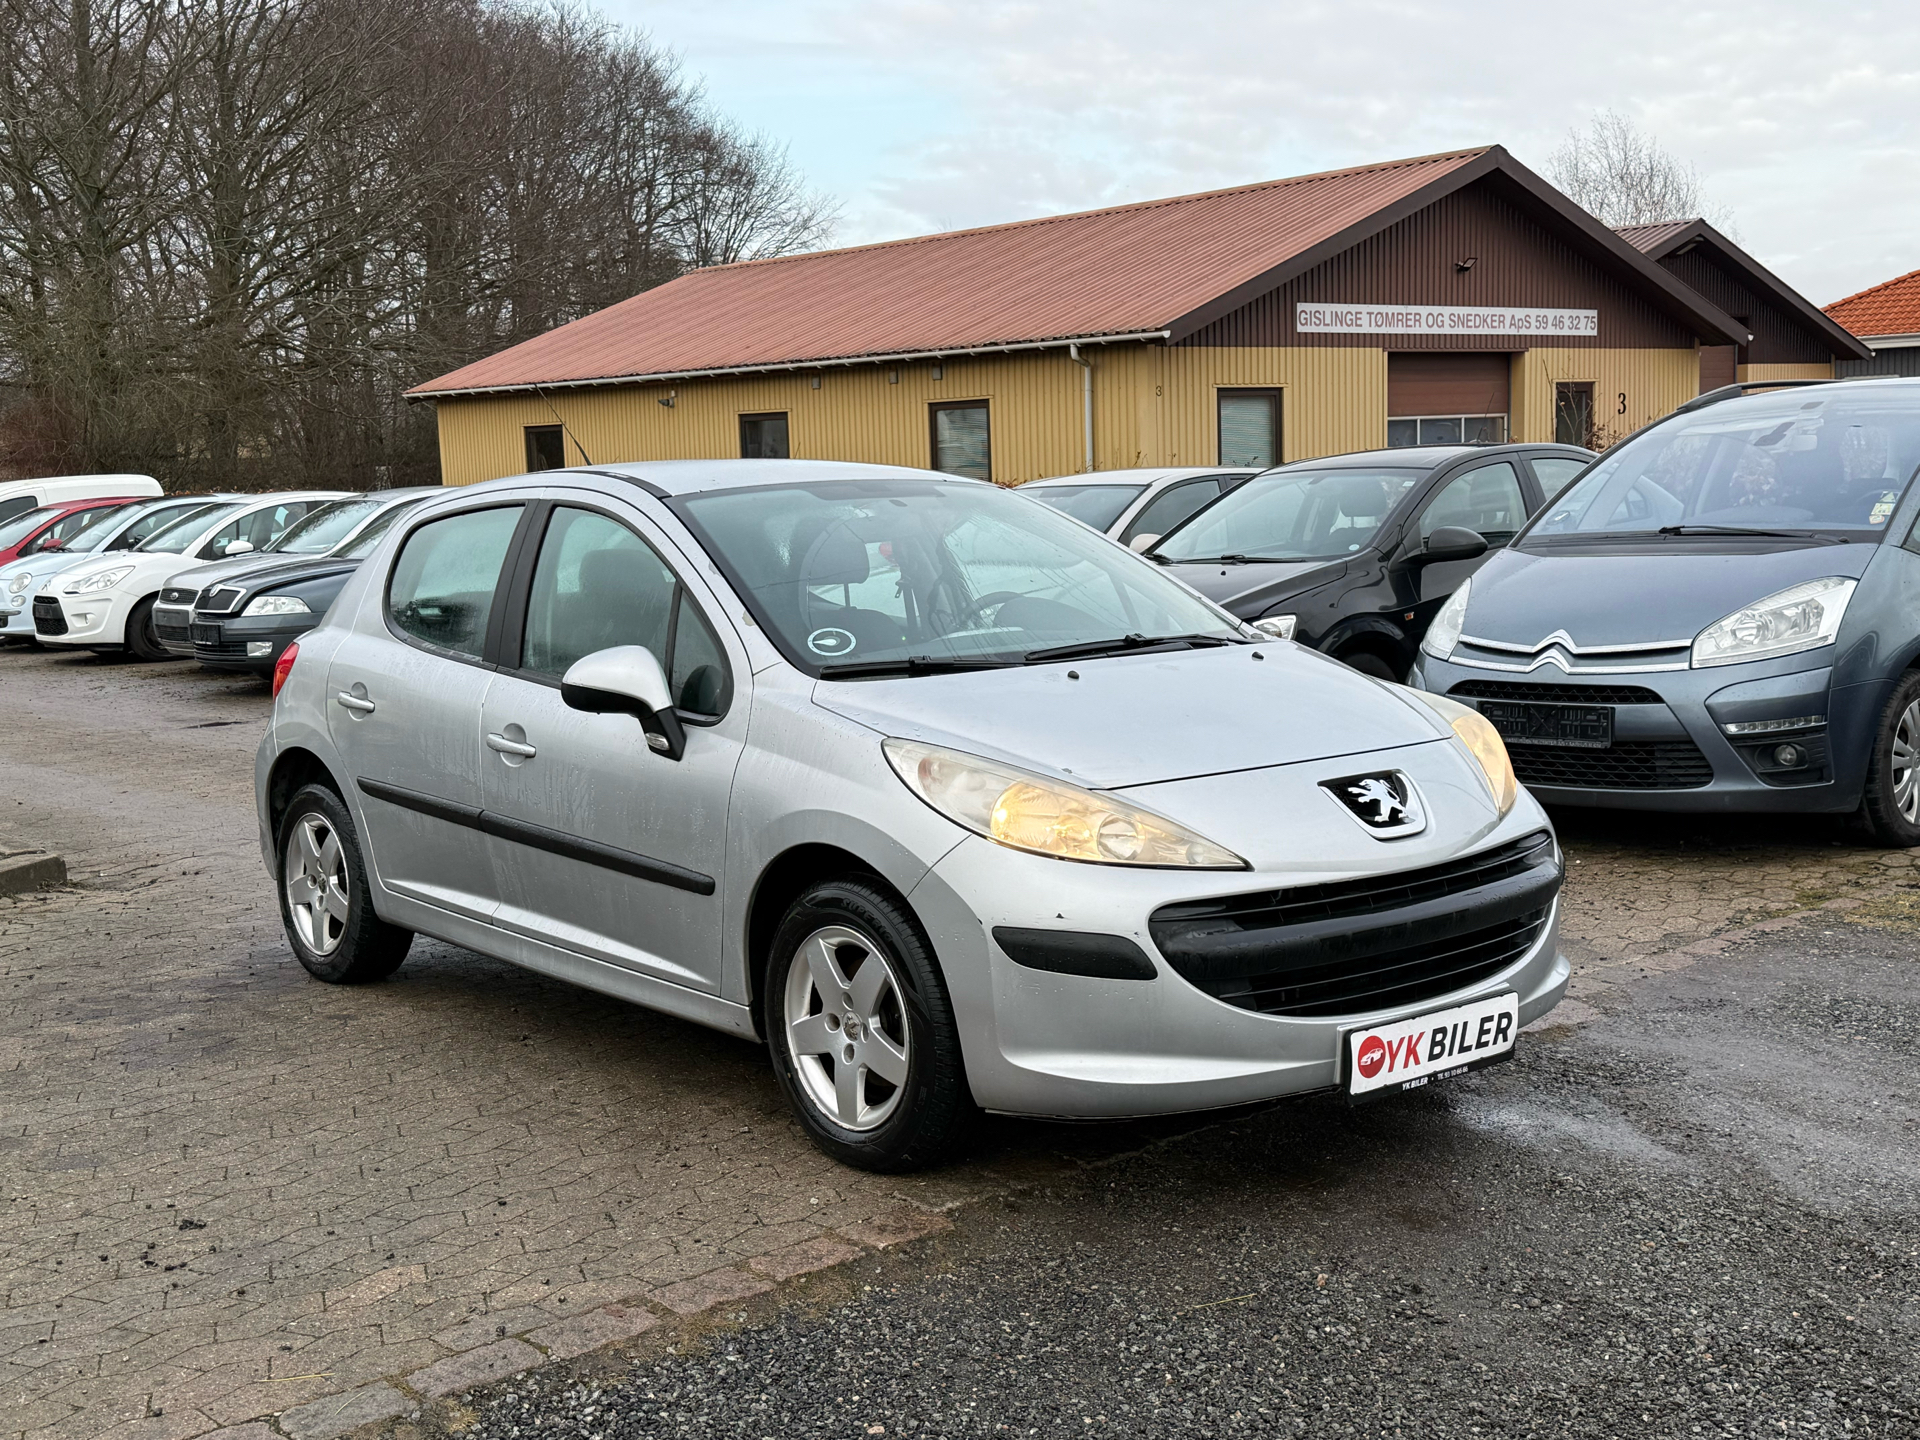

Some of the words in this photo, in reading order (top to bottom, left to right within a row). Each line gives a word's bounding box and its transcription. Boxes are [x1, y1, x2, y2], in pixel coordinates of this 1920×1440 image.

[1298, 309, 1363, 327] GISLINGE
[1366, 311, 1422, 328] TØMRER
[1425, 312, 1445, 328] OG
[1448, 313, 1506, 329] SNEDKER
[1509, 314, 1532, 333] ApS
[1535, 314, 1548, 330] 59
[1551, 315, 1565, 331] 46
[1567, 315, 1581, 331] 32
[1583, 315, 1597, 331] 75
[1155, 385, 1163, 397] 3
[1617, 392, 1627, 415] 3
[1386, 1031, 1426, 1073] YK
[1427, 1011, 1513, 1062] BILER
[1402, 1082, 1410, 1091] YK
[1411, 1076, 1428, 1088] BILER
